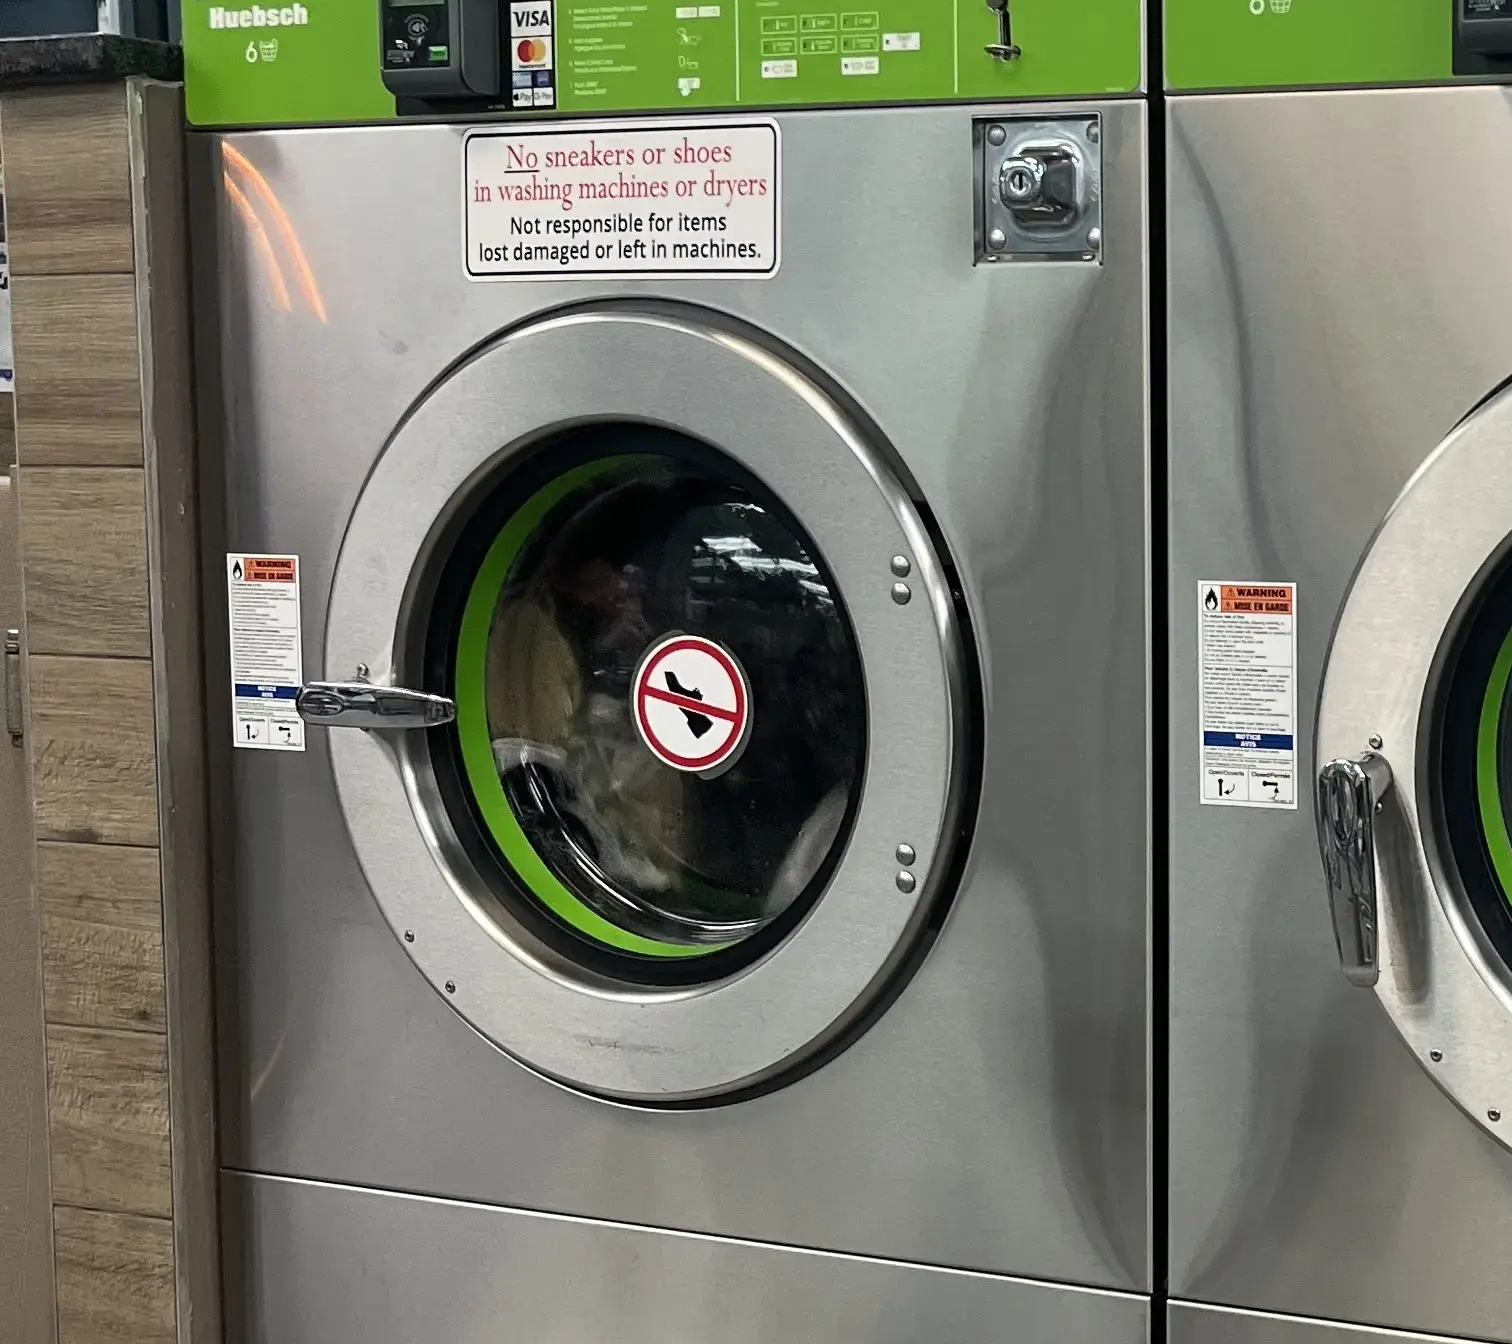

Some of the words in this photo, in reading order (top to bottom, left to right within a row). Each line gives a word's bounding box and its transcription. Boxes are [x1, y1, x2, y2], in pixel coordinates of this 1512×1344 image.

[209, 3, 308, 29] Huebsch
[513, 11, 550, 27] VISA
[245, 40, 258, 63] 6
[506, 145, 538, 169] No
[545, 141, 634, 167] sneakers
[642, 146, 666, 164] or
[674, 137, 732, 163] shoes
[474, 179, 491, 202] in
[498, 175, 572, 210] washing
[579, 172, 668, 199] machines
[675, 179, 697, 196] or
[703, 170, 767, 207] dryers
[510, 216, 540, 235] Not
[546, 213, 643, 239] responsible
[648, 212, 673, 232] for
[678, 213, 727, 232] items
[479, 243, 508, 262] lost
[513, 241, 589, 265] damaged
[595, 244, 613, 259] or
[618, 239, 646, 259] left
[652, 240, 667, 258] in
[673, 237, 761, 258] machines.
[1237, 588, 1286, 598] WARNING
[1234, 601, 1252, 610] MISE
[1254, 602, 1263, 611] EN
[1265, 602, 1289, 612] GARDE
